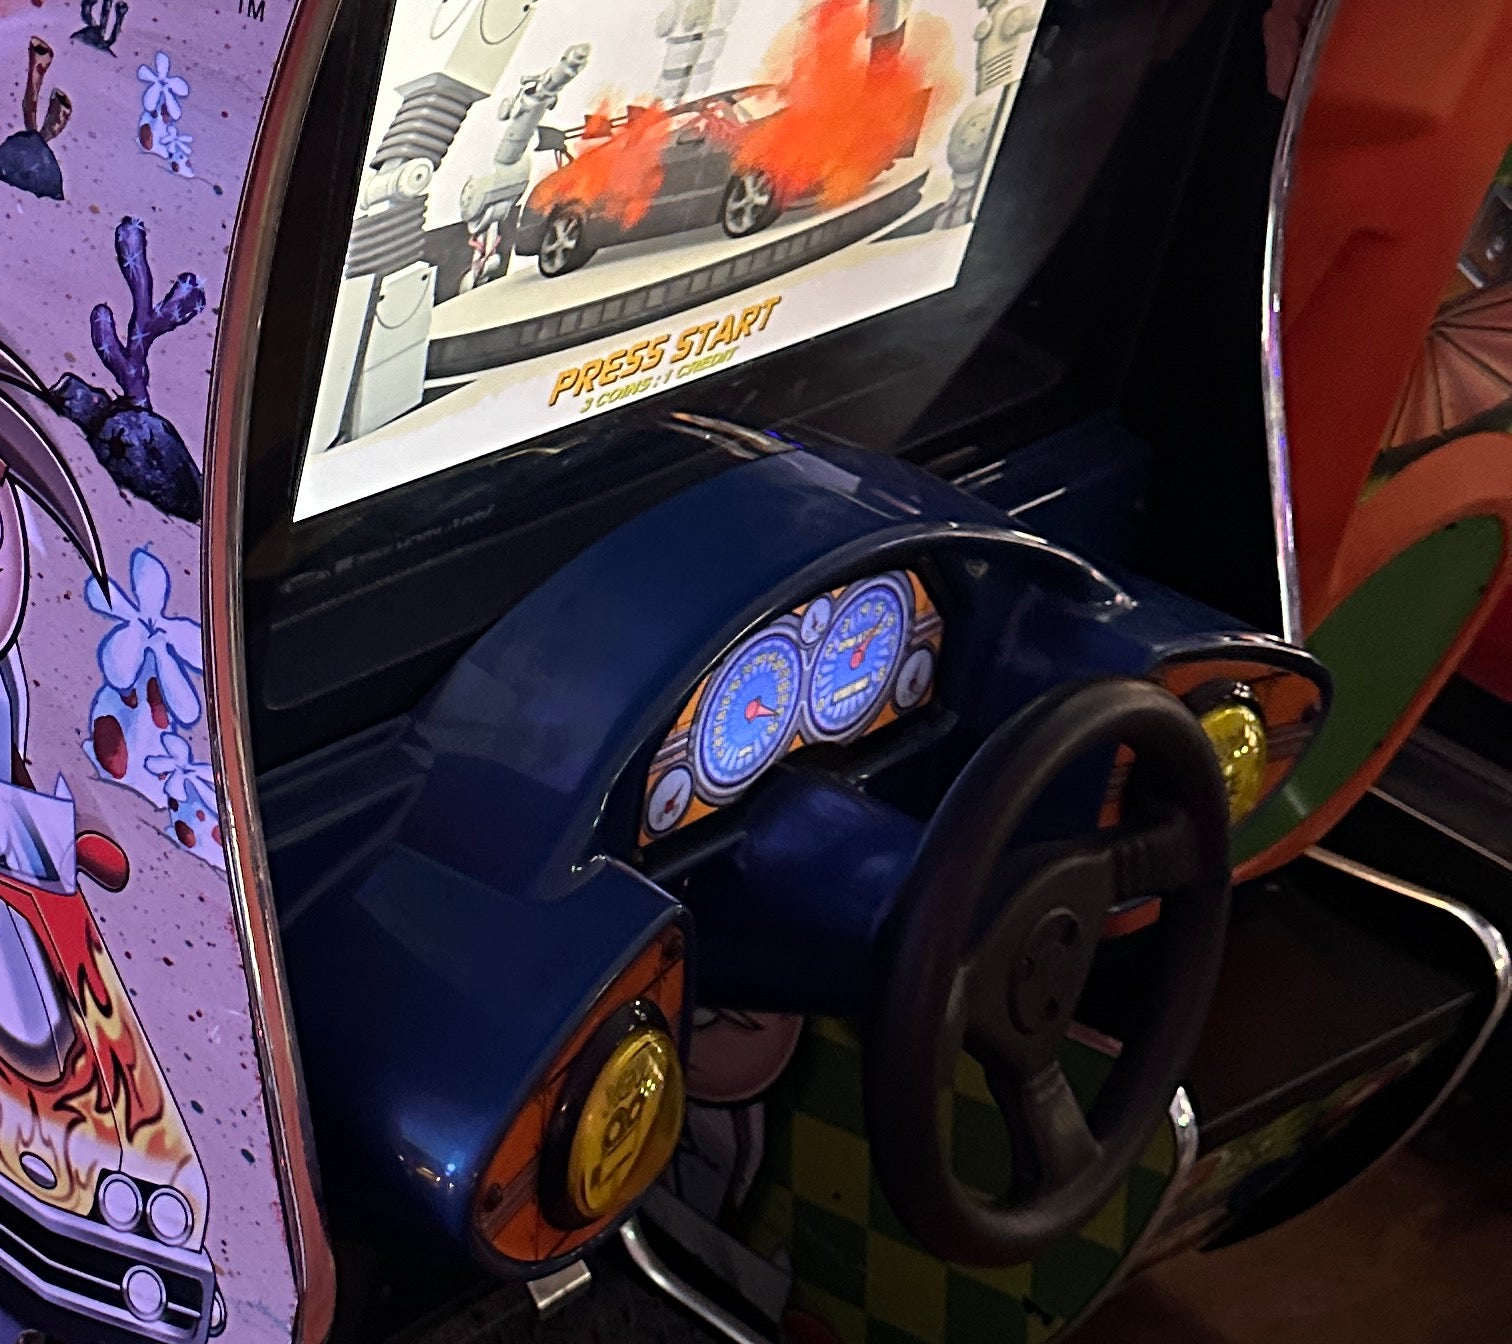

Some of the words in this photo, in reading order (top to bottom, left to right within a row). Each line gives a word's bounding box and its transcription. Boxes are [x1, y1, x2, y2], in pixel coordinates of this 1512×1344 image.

[548, 333, 672, 407] PRESS
[670, 295, 782, 364] START
[580, 397, 594, 413] 3
[676, 345, 741, 379] CREDIT
